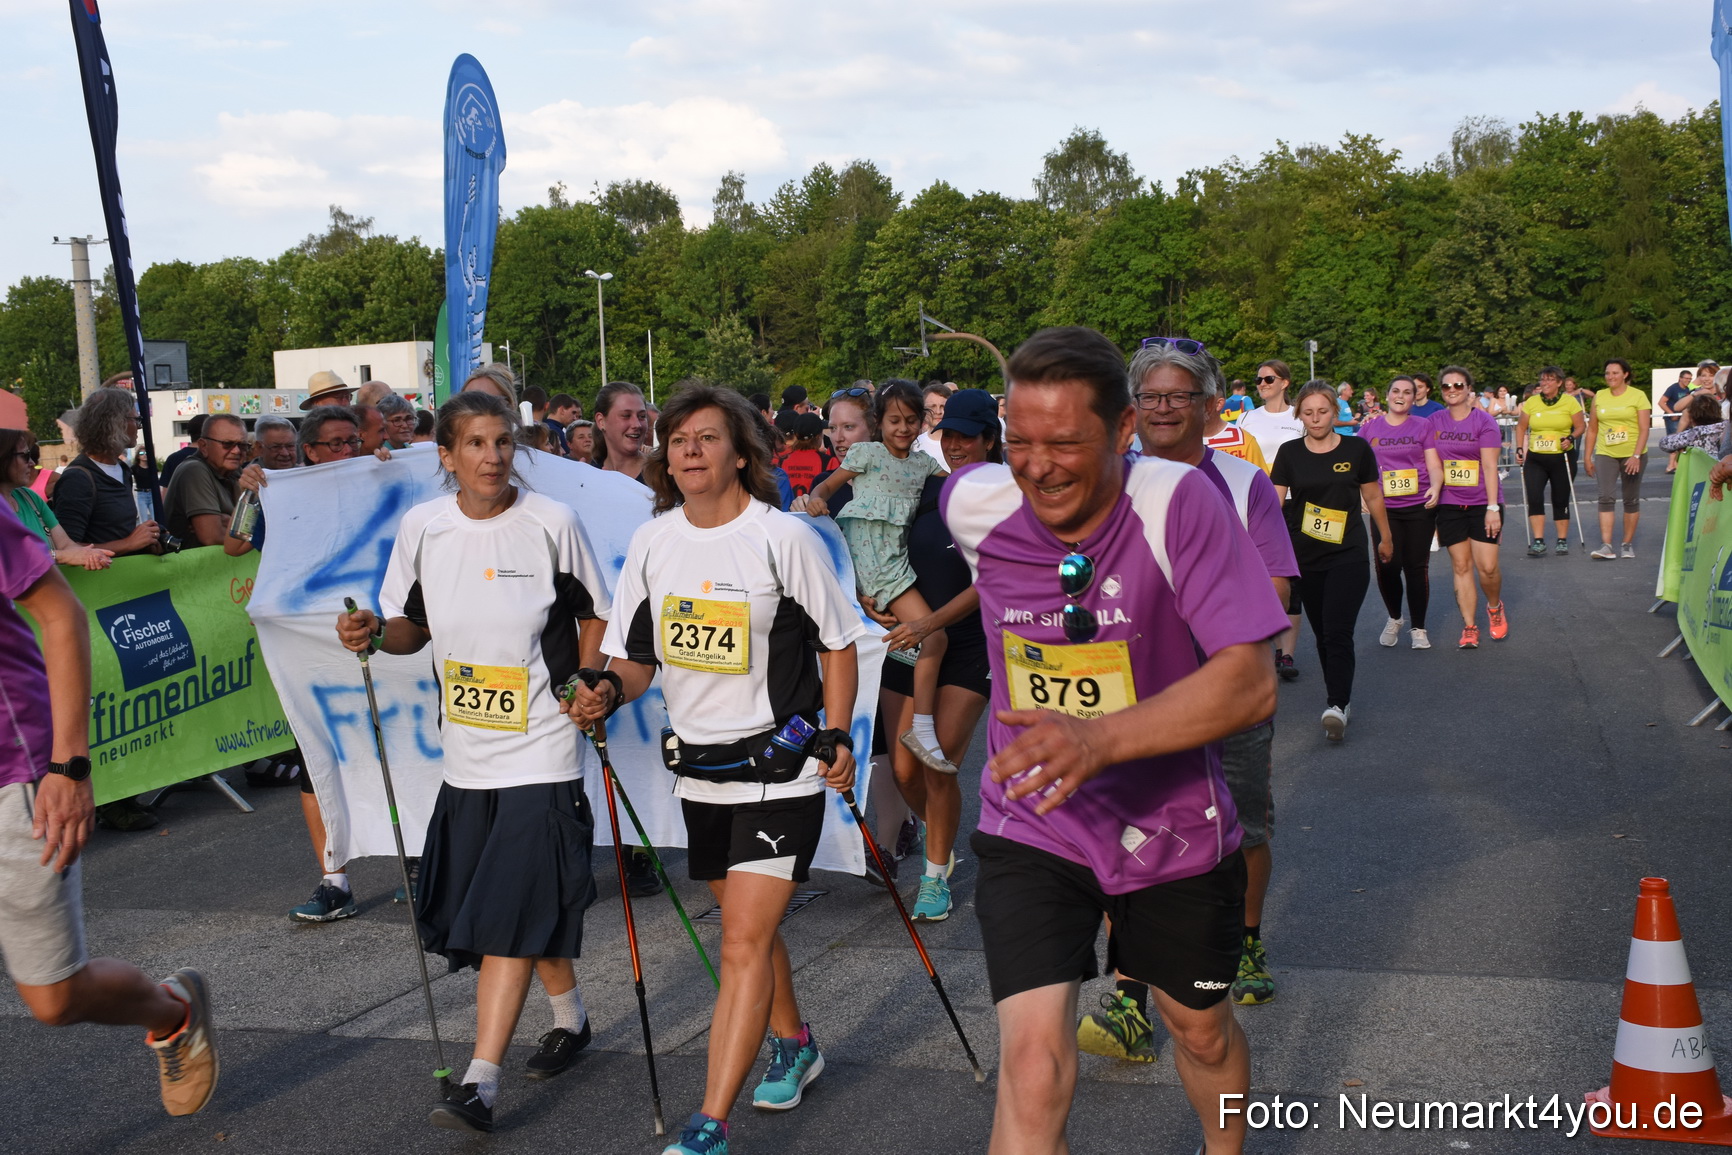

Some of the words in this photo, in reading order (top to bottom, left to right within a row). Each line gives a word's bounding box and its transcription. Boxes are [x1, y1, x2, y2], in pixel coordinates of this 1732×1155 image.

[1378, 436, 1416, 446] GRADL
[1440, 430, 1476, 442] GRADL
[1607, 431, 1626, 440] 1242
[1450, 469, 1470, 478] 940
[1390, 478, 1410, 488] 938
[1313, 518, 1330, 532] 81
[1004, 607, 1035, 625] WIR
[122, 619, 172, 644] Fischer
[670, 622, 736, 653] 2374
[135, 632, 174, 651] AUTOMOBILE
[697, 652, 726, 660] Angelika
[93, 637, 255, 744] firmenlauf
[453, 684, 515, 713] 2376
[1029, 673, 1101, 708] 879
[458, 708, 482, 718] Heinrich
[484, 711, 510, 720] Barbara
[100, 720, 175, 767] neumarkt
